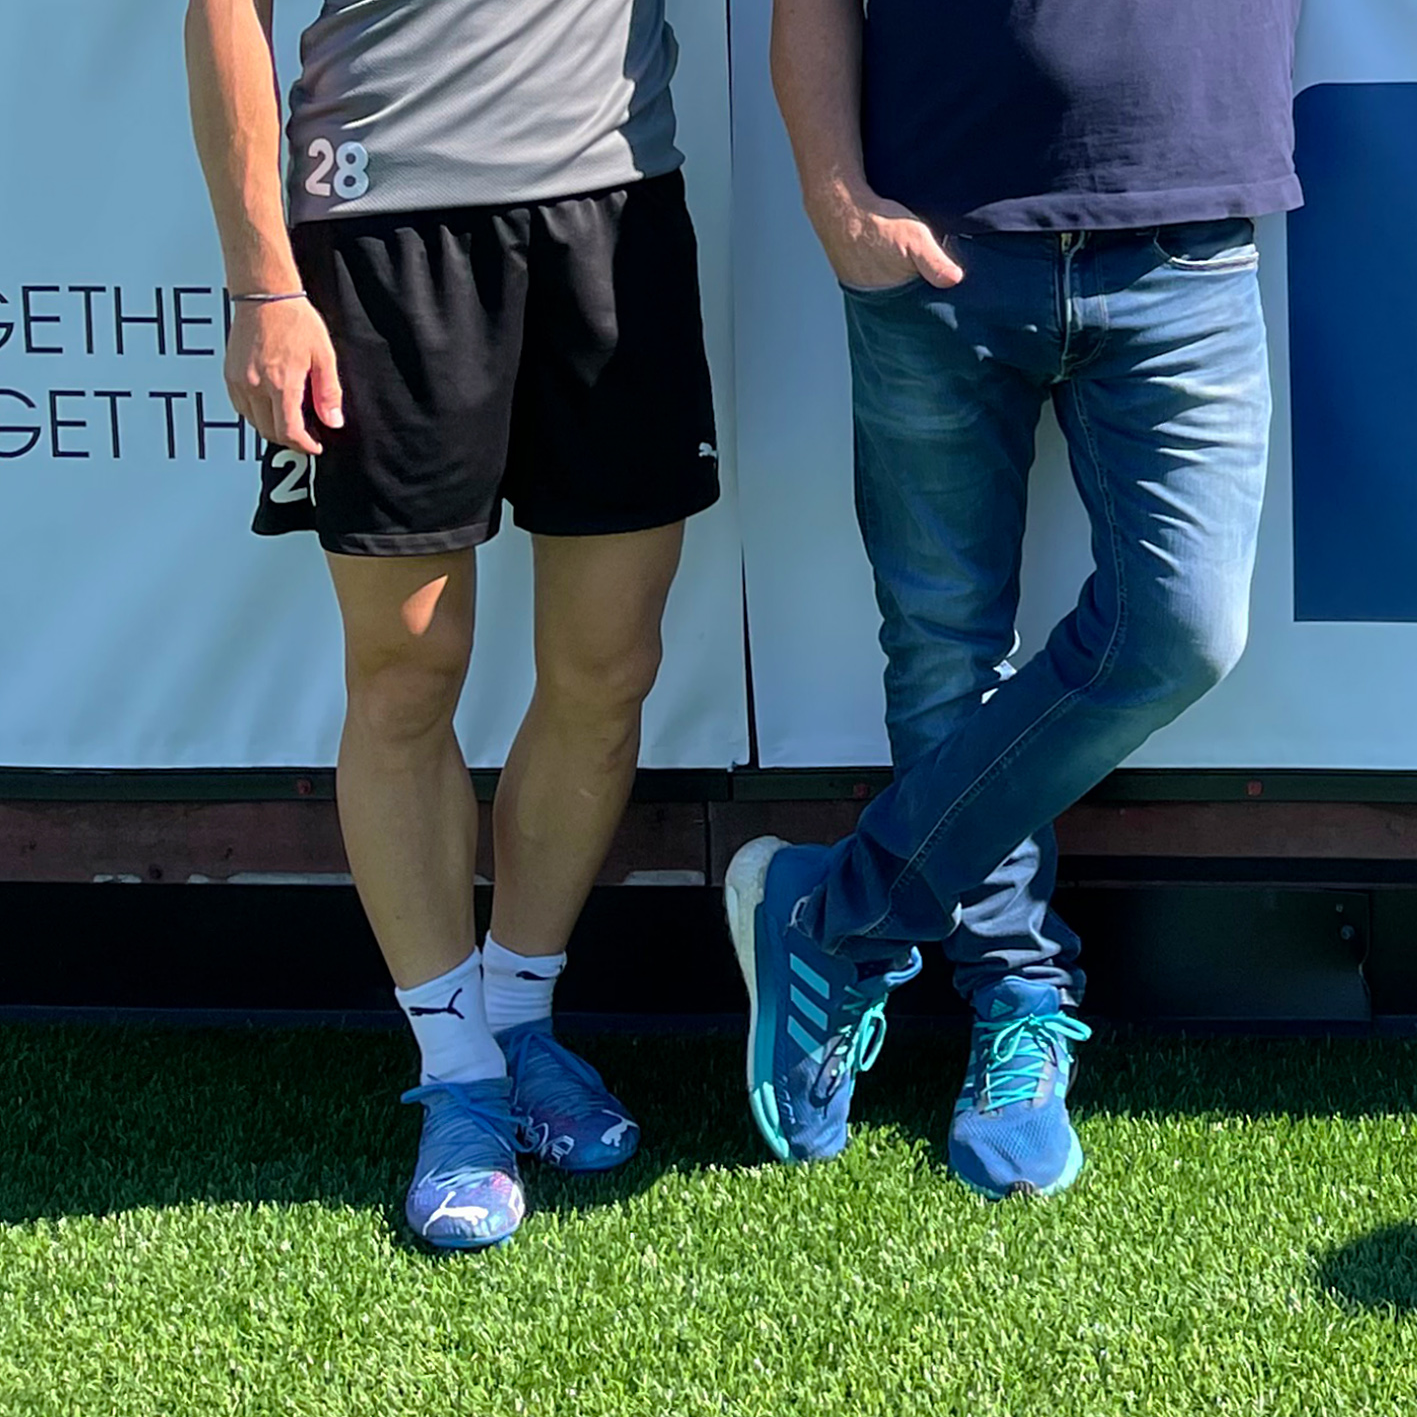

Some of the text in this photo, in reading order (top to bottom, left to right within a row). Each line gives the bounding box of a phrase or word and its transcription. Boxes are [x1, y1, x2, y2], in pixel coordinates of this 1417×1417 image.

[305, 138, 369, 200] 28
[0, 285, 231, 357] ETHE
[149, 391, 264, 461] TH
[269, 449, 317, 507] 2
